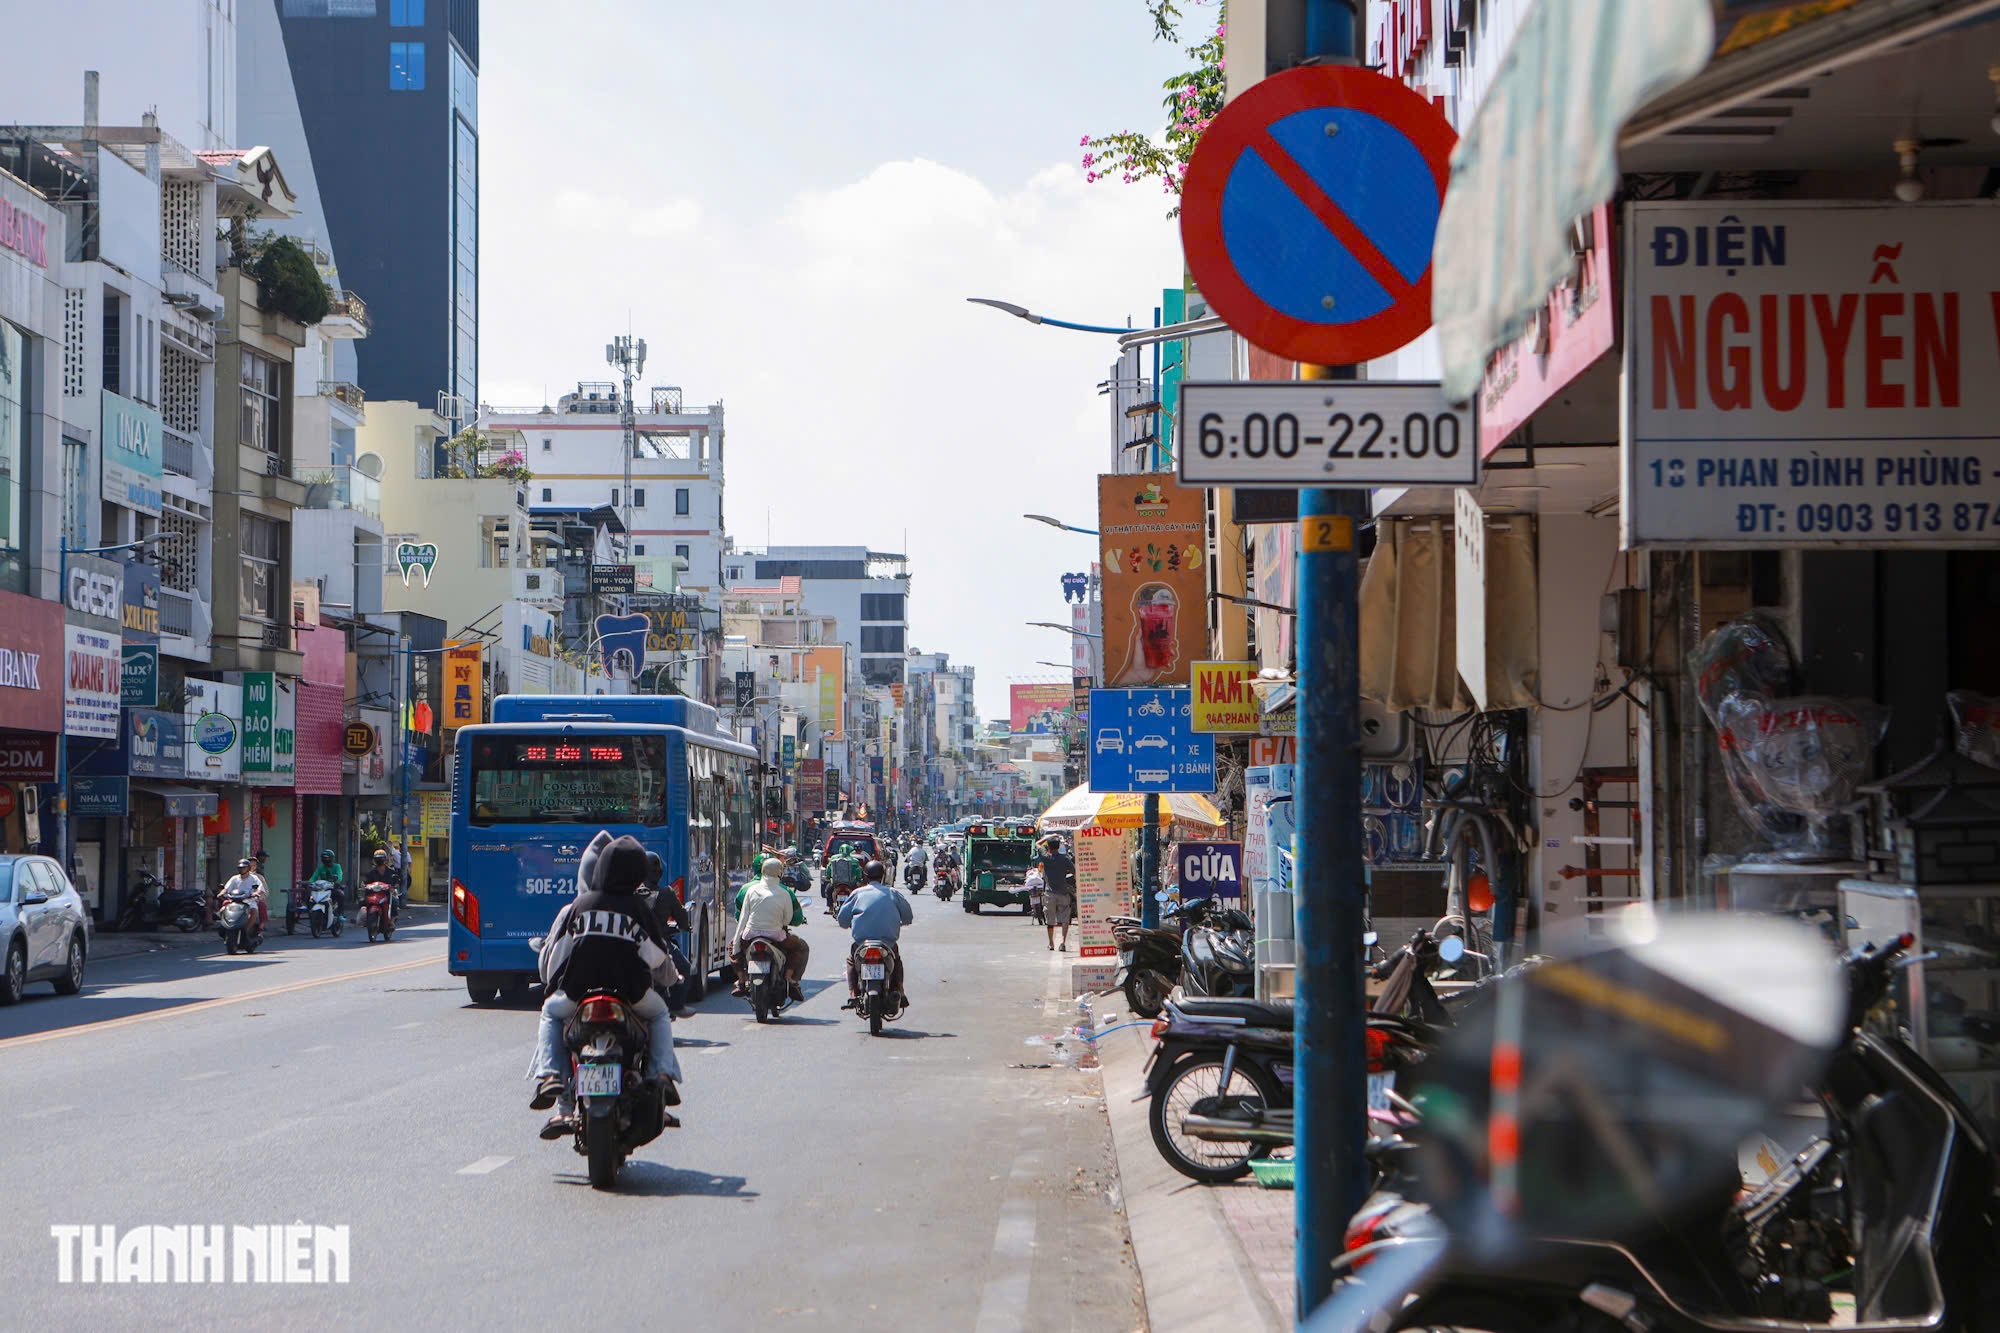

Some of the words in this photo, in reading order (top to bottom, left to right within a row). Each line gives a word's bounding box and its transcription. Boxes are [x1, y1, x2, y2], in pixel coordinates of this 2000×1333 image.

[1650, 216, 1787, 276] ĐIỆN
[1650, 242, 1960, 412] NGUYỄN
[119, 413, 149, 458] INAX
[1200, 412, 1460, 459] 6:00-22:00
[1697, 458, 1779, 487] PHAN
[1789, 450, 1865, 487] ĐÌNH
[1877, 449, 1982, 487] PHÙNG
[1737, 504, 1786, 532] ĐT:
[1797, 503, 1874, 532] 0903
[1885, 503, 1942, 532] 913
[1318, 522, 1332, 545] 2
[401, 556, 434, 564] DENTIST
[614, 577, 633, 585] YOGA
[647, 633, 694, 652] OGA
[1200, 670, 1243, 704] NAM
[1226, 713, 1251, 724] PHAN
[243, 737, 270, 764] HIỂM
[1188, 744, 1200, 756] XE
[1178, 763, 1185, 774] 2
[1186, 760, 1211, 774] BÁNH
[1081, 827, 1122, 838] MENU
[1184, 846, 1237, 882] CỬA
